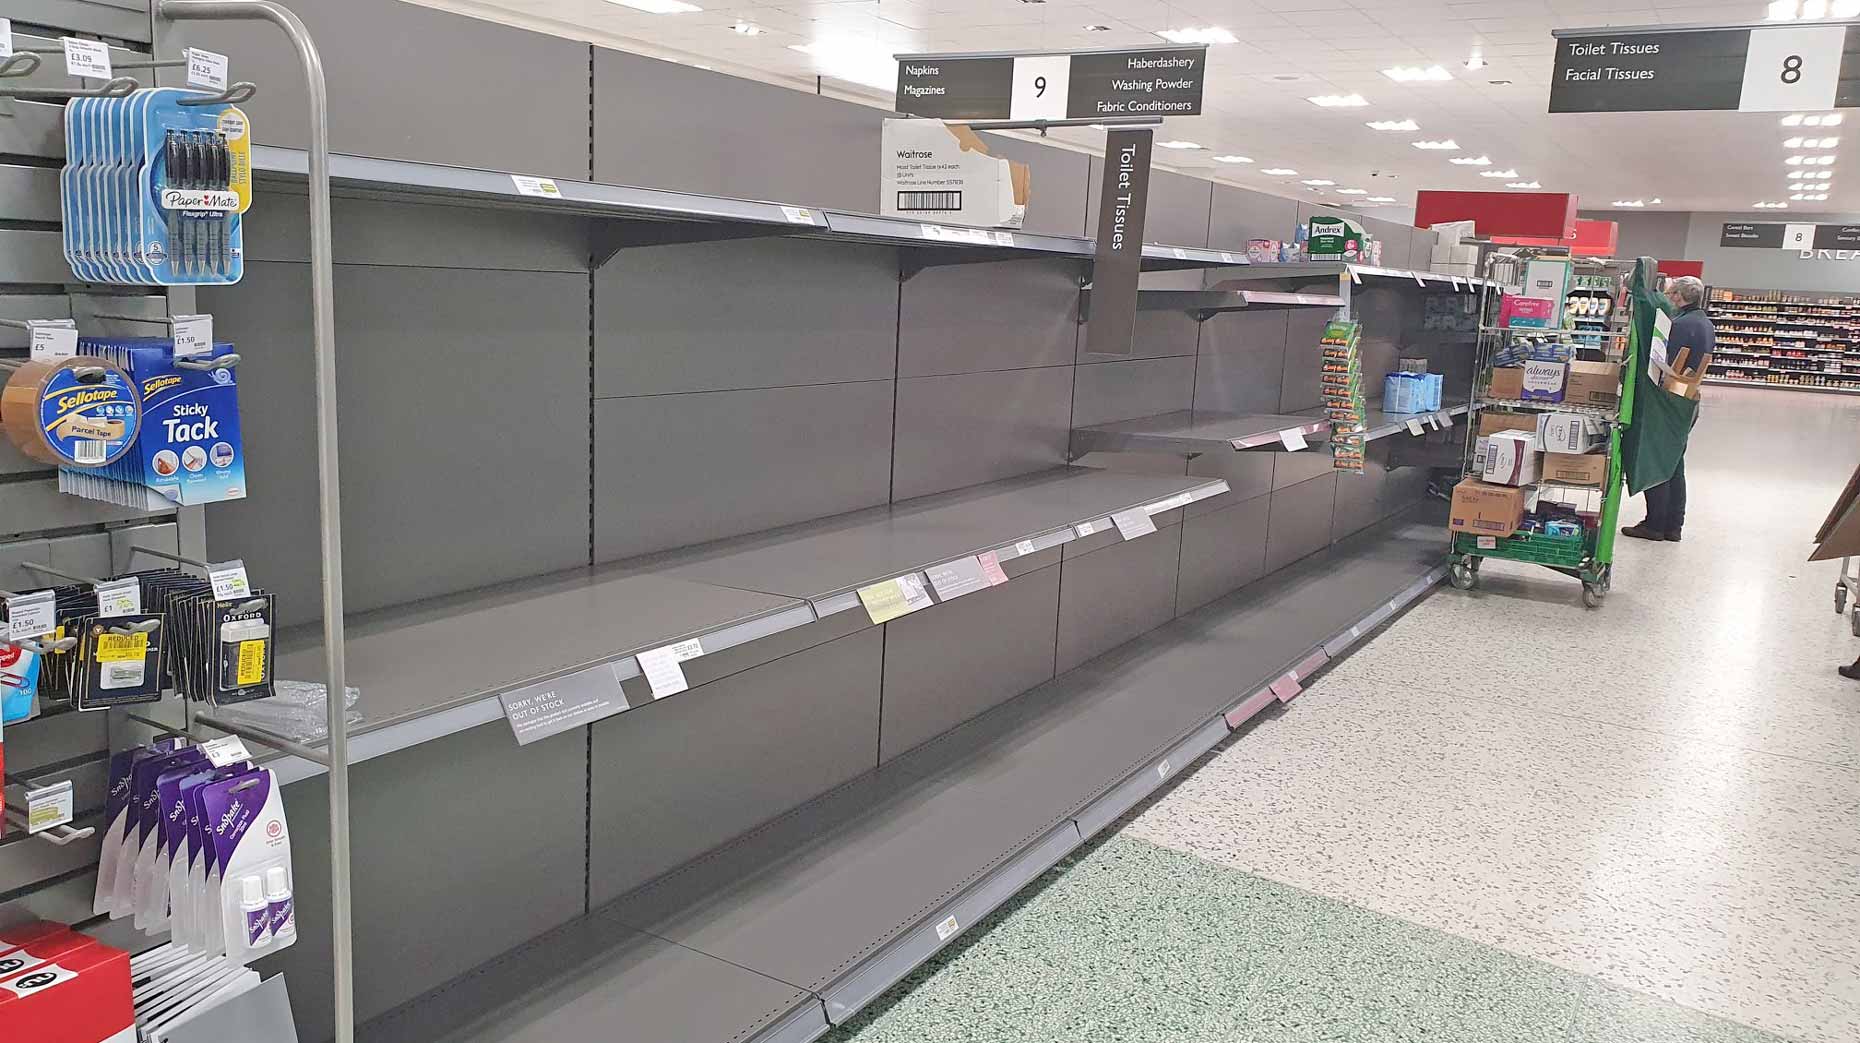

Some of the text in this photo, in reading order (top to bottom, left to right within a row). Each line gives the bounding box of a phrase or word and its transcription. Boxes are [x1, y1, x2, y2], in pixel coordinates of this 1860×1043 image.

[1569, 42, 1660, 56] Toilet Tissues
[1127, 57, 1195, 70] Haberdashery
[1780, 54, 1803, 84] 8
[905, 65, 940, 77] Napkins
[1565, 67, 1654, 81] Facial Tissues
[903, 85, 945, 98] Magazines
[1034, 76, 1047, 98] 9
[1112, 77, 1194, 93] Washing Powder
[1097, 100, 1192, 112] Fabric Conditioners
[896, 149, 932, 159] Waitrose
[166, 191, 237, 208] Paper Mate
[1112, 143, 1135, 250] Toilet Tissues
[1315, 226, 1341, 234] Andrex
[1795, 233, 1803, 241] 8
[177, 336, 195, 345] £1.50
[1526, 365, 1560, 379] always
[143, 376, 181, 396] Sellotape
[57, 389, 117, 414] Sellotape
[173, 403, 208, 417] Sticky
[71, 425, 111, 437] Parcel Tape
[162, 415, 219, 443] Tack
[104, 605, 112, 613] £1
[12, 619, 34, 630] £1.50
[508, 690, 557, 712] SORRY, WE'RE
[512, 698, 564, 720] OUT OF STOCK
